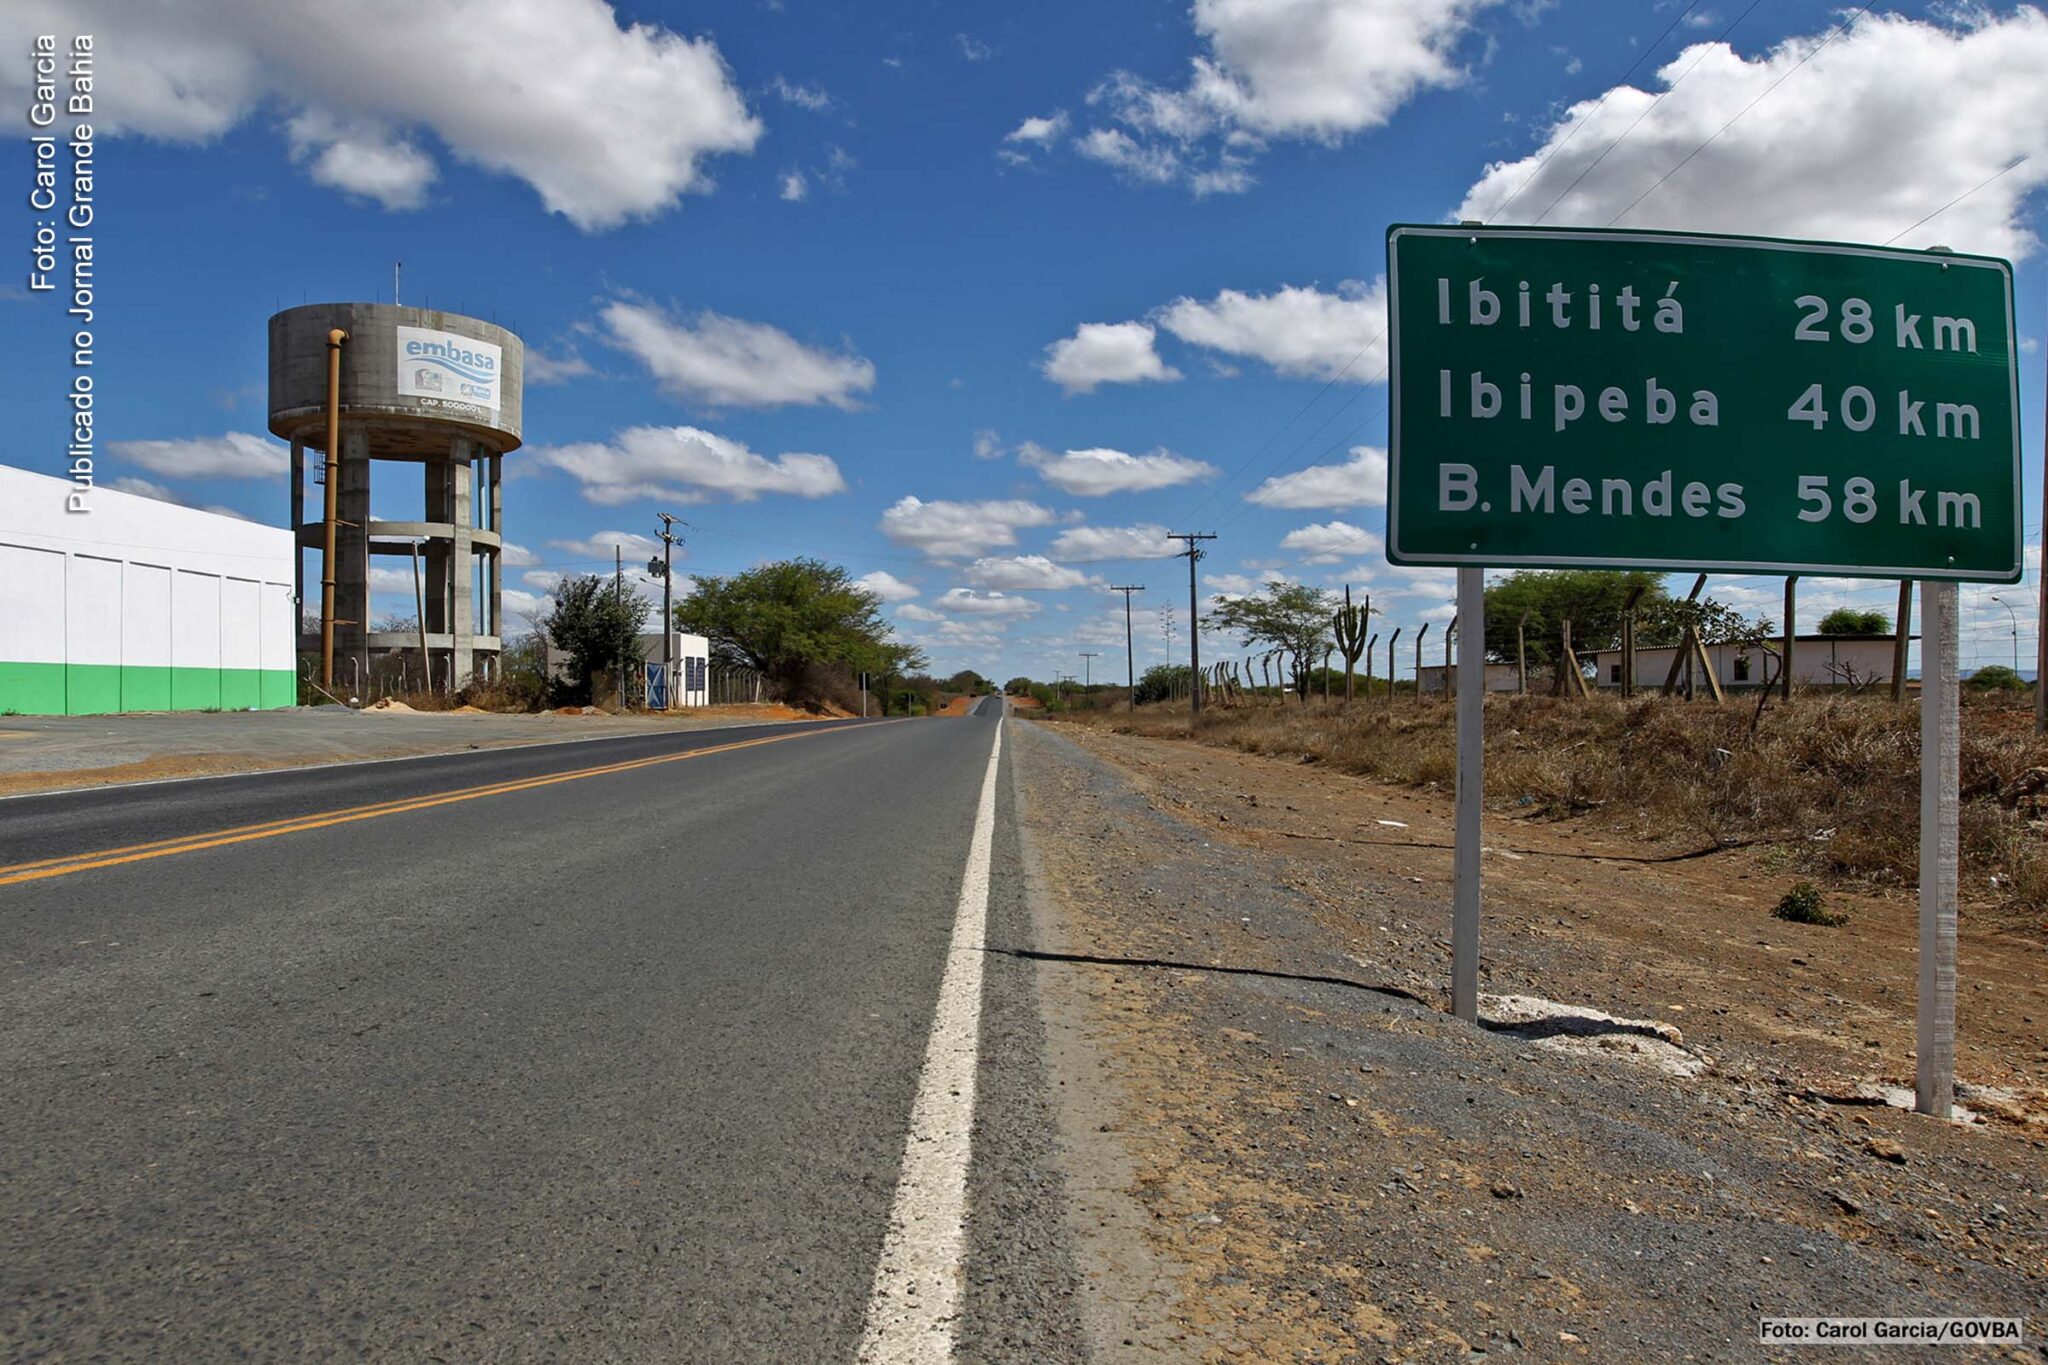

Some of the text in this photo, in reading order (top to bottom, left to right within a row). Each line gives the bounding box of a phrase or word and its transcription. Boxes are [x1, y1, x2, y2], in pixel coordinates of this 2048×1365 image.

[1438, 279, 1979, 354] Ibititá 28 km
[406, 339, 495, 370] embasa
[1439, 370, 1981, 440] Ibipeba 40 km
[1439, 463, 1982, 529] B. Mendes 58 km
